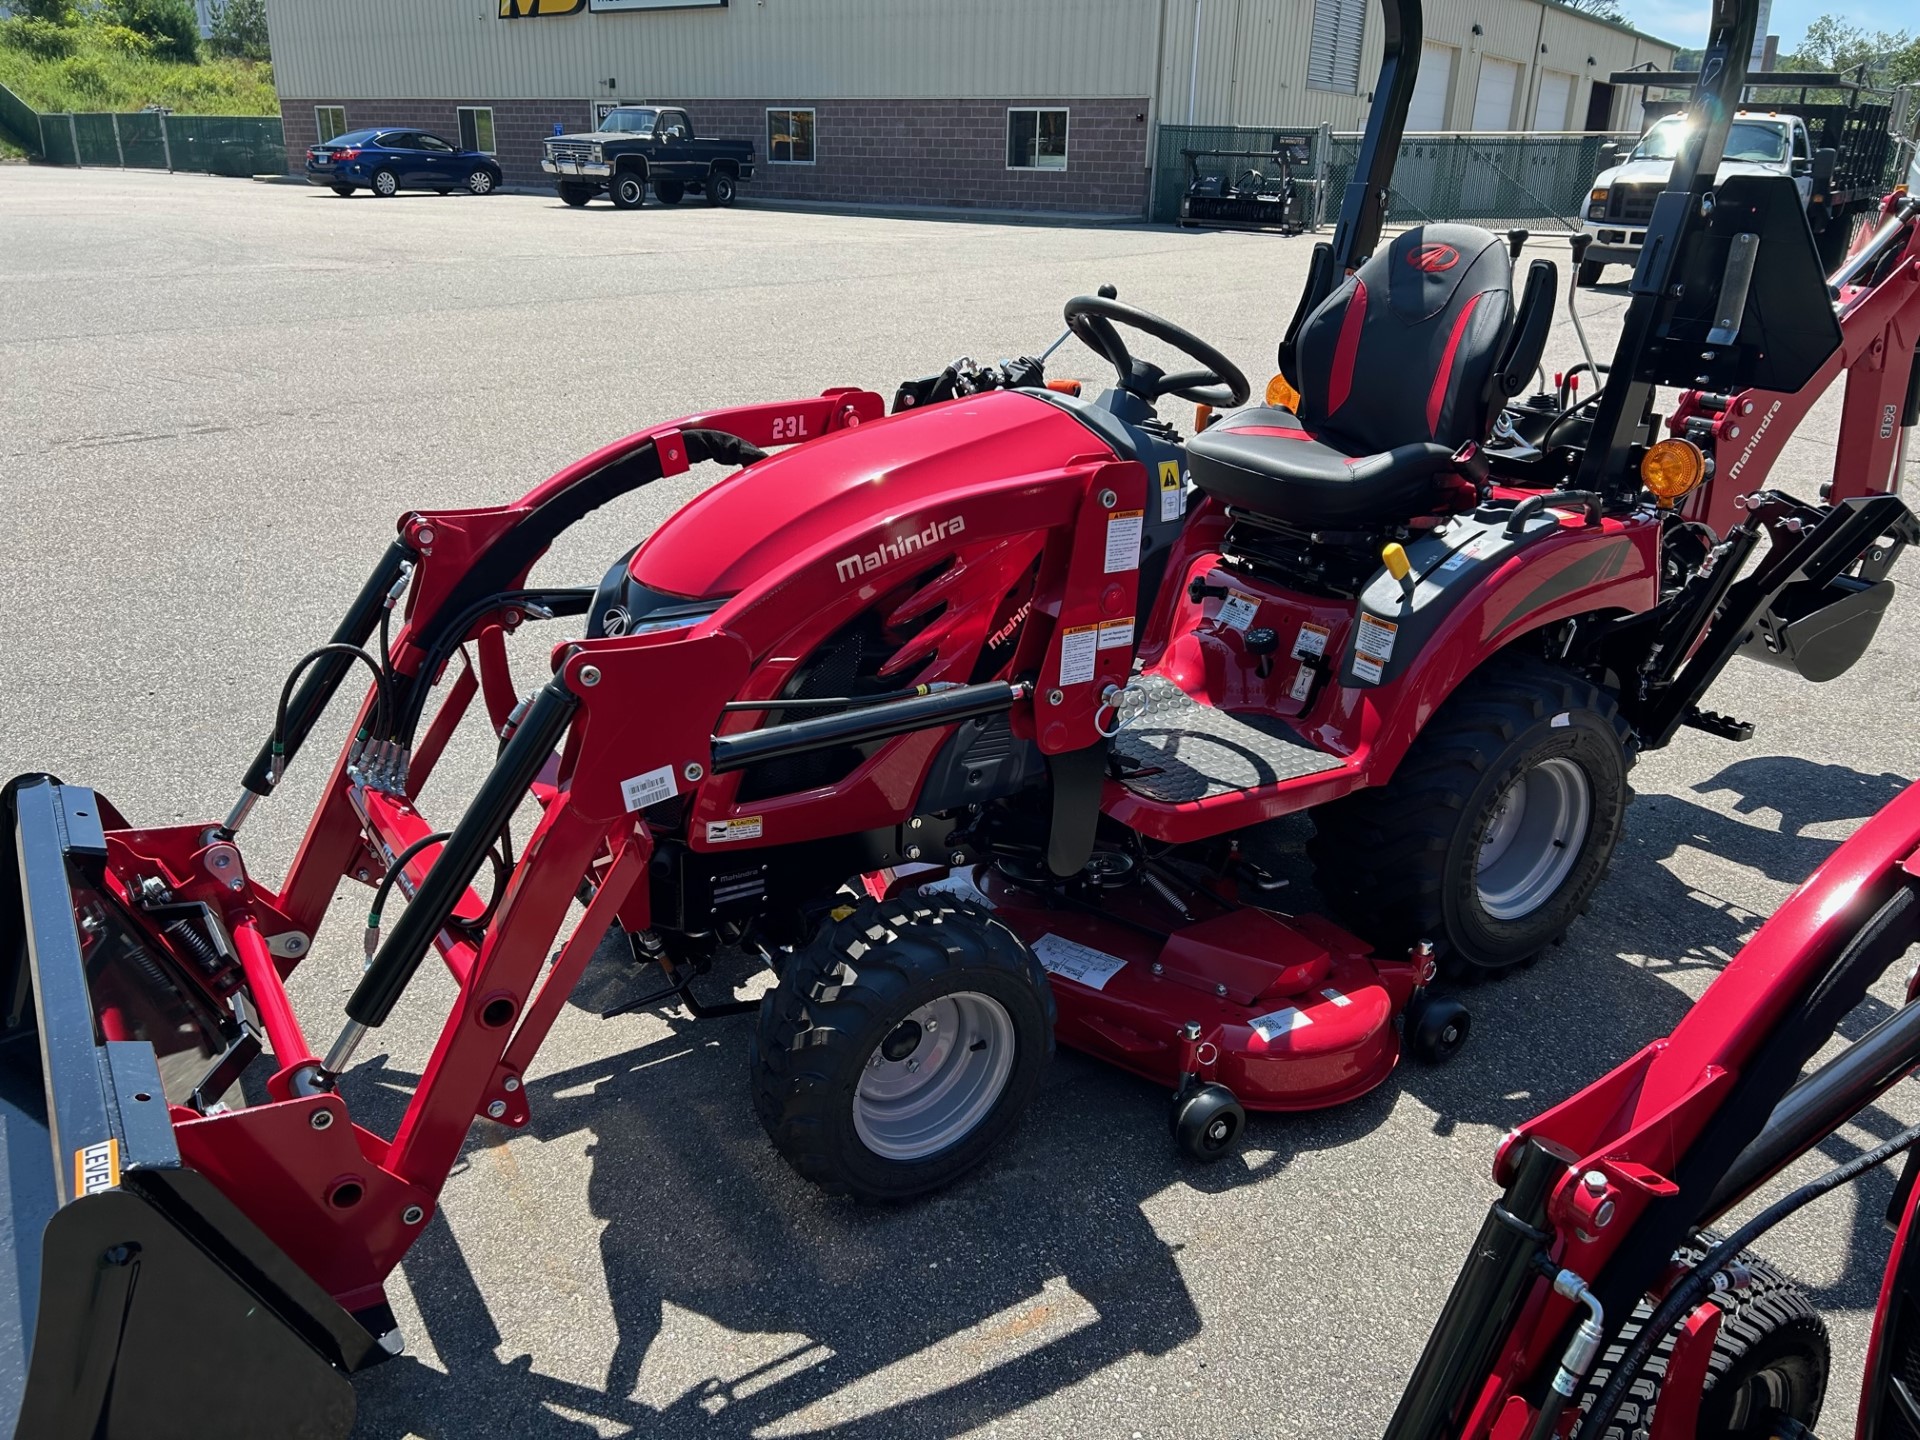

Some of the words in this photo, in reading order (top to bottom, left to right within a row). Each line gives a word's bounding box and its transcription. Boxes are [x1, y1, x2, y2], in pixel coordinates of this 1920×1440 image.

[772, 414, 808, 440] 23L
[1729, 400, 1782, 480] Mahindra
[1880, 404, 1897, 439] 23B
[836, 515, 966, 583] Mahindra
[720, 869, 759, 883] Mahindra
[85, 1145, 110, 1195] LEVEL
